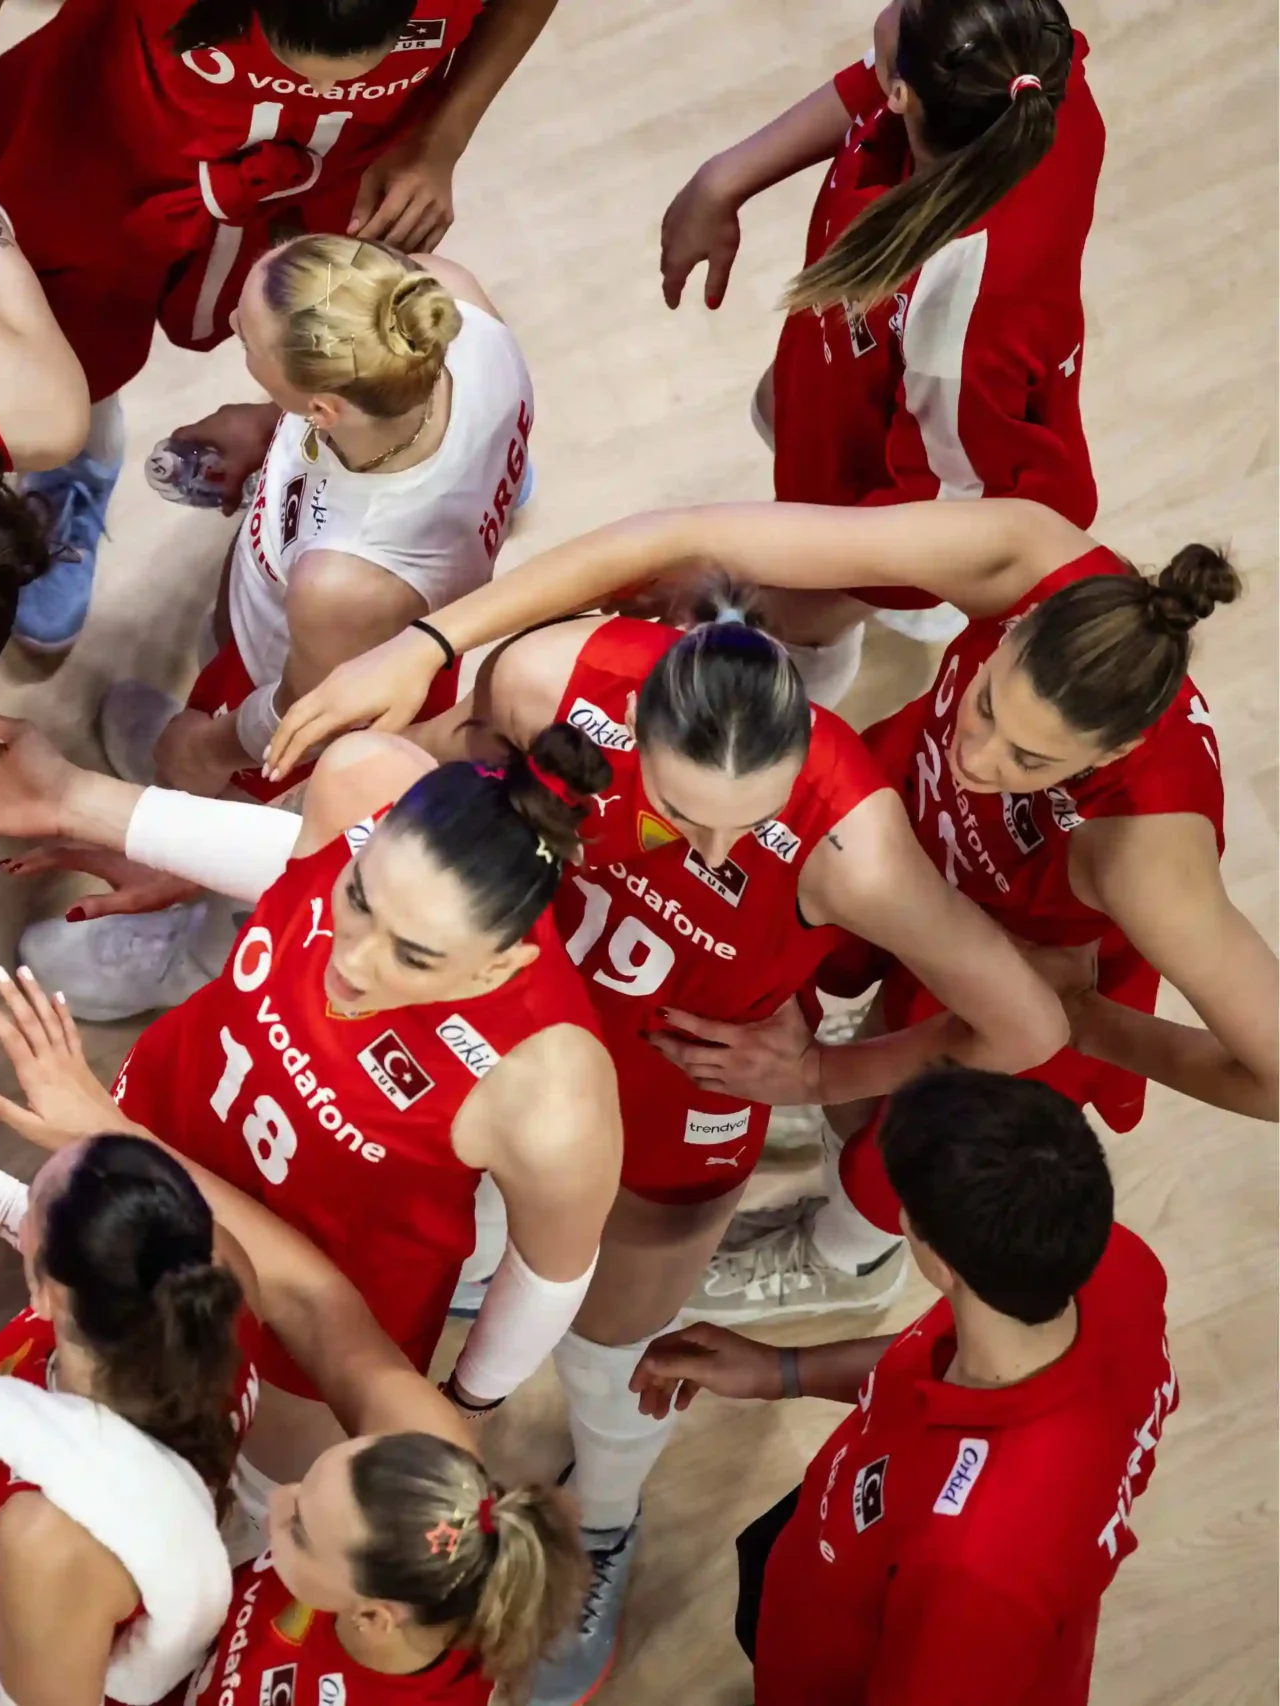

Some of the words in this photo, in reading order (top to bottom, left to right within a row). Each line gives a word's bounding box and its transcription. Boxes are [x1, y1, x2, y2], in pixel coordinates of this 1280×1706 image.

[478, 400, 532, 560] ÖRGE
[754, 822, 799, 860] rkid
[605, 862, 737, 960] odafone
[698, 867, 727, 896] TUR
[565, 874, 676, 997] 19
[209, 1025, 298, 1185] 18
[256, 996, 387, 1163] vodafone
[370, 1064, 398, 1098] TUR
[689, 1116, 748, 1134] trendyol
[941, 1447, 978, 1505] Orkid
